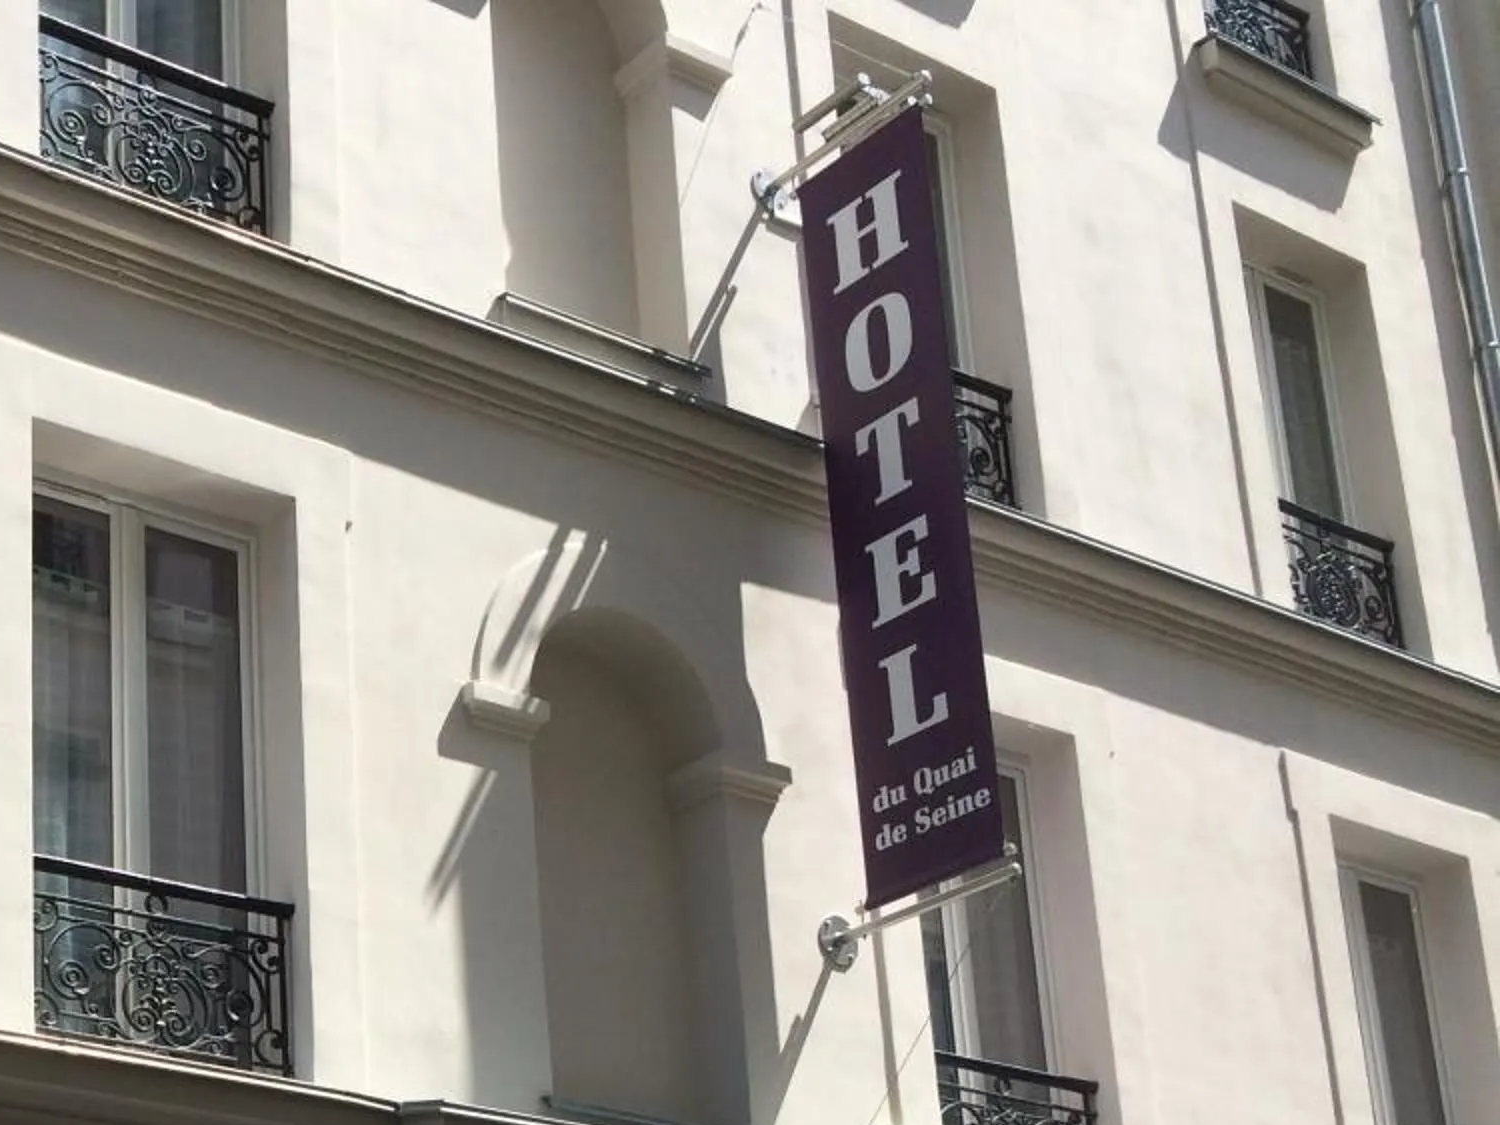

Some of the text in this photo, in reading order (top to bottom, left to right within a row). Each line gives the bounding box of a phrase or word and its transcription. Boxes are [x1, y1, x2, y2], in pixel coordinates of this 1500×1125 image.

[825, 169, 950, 747] HOTEL
[872, 745, 978, 814] du Quai
[875, 787, 992, 851] de Seine
